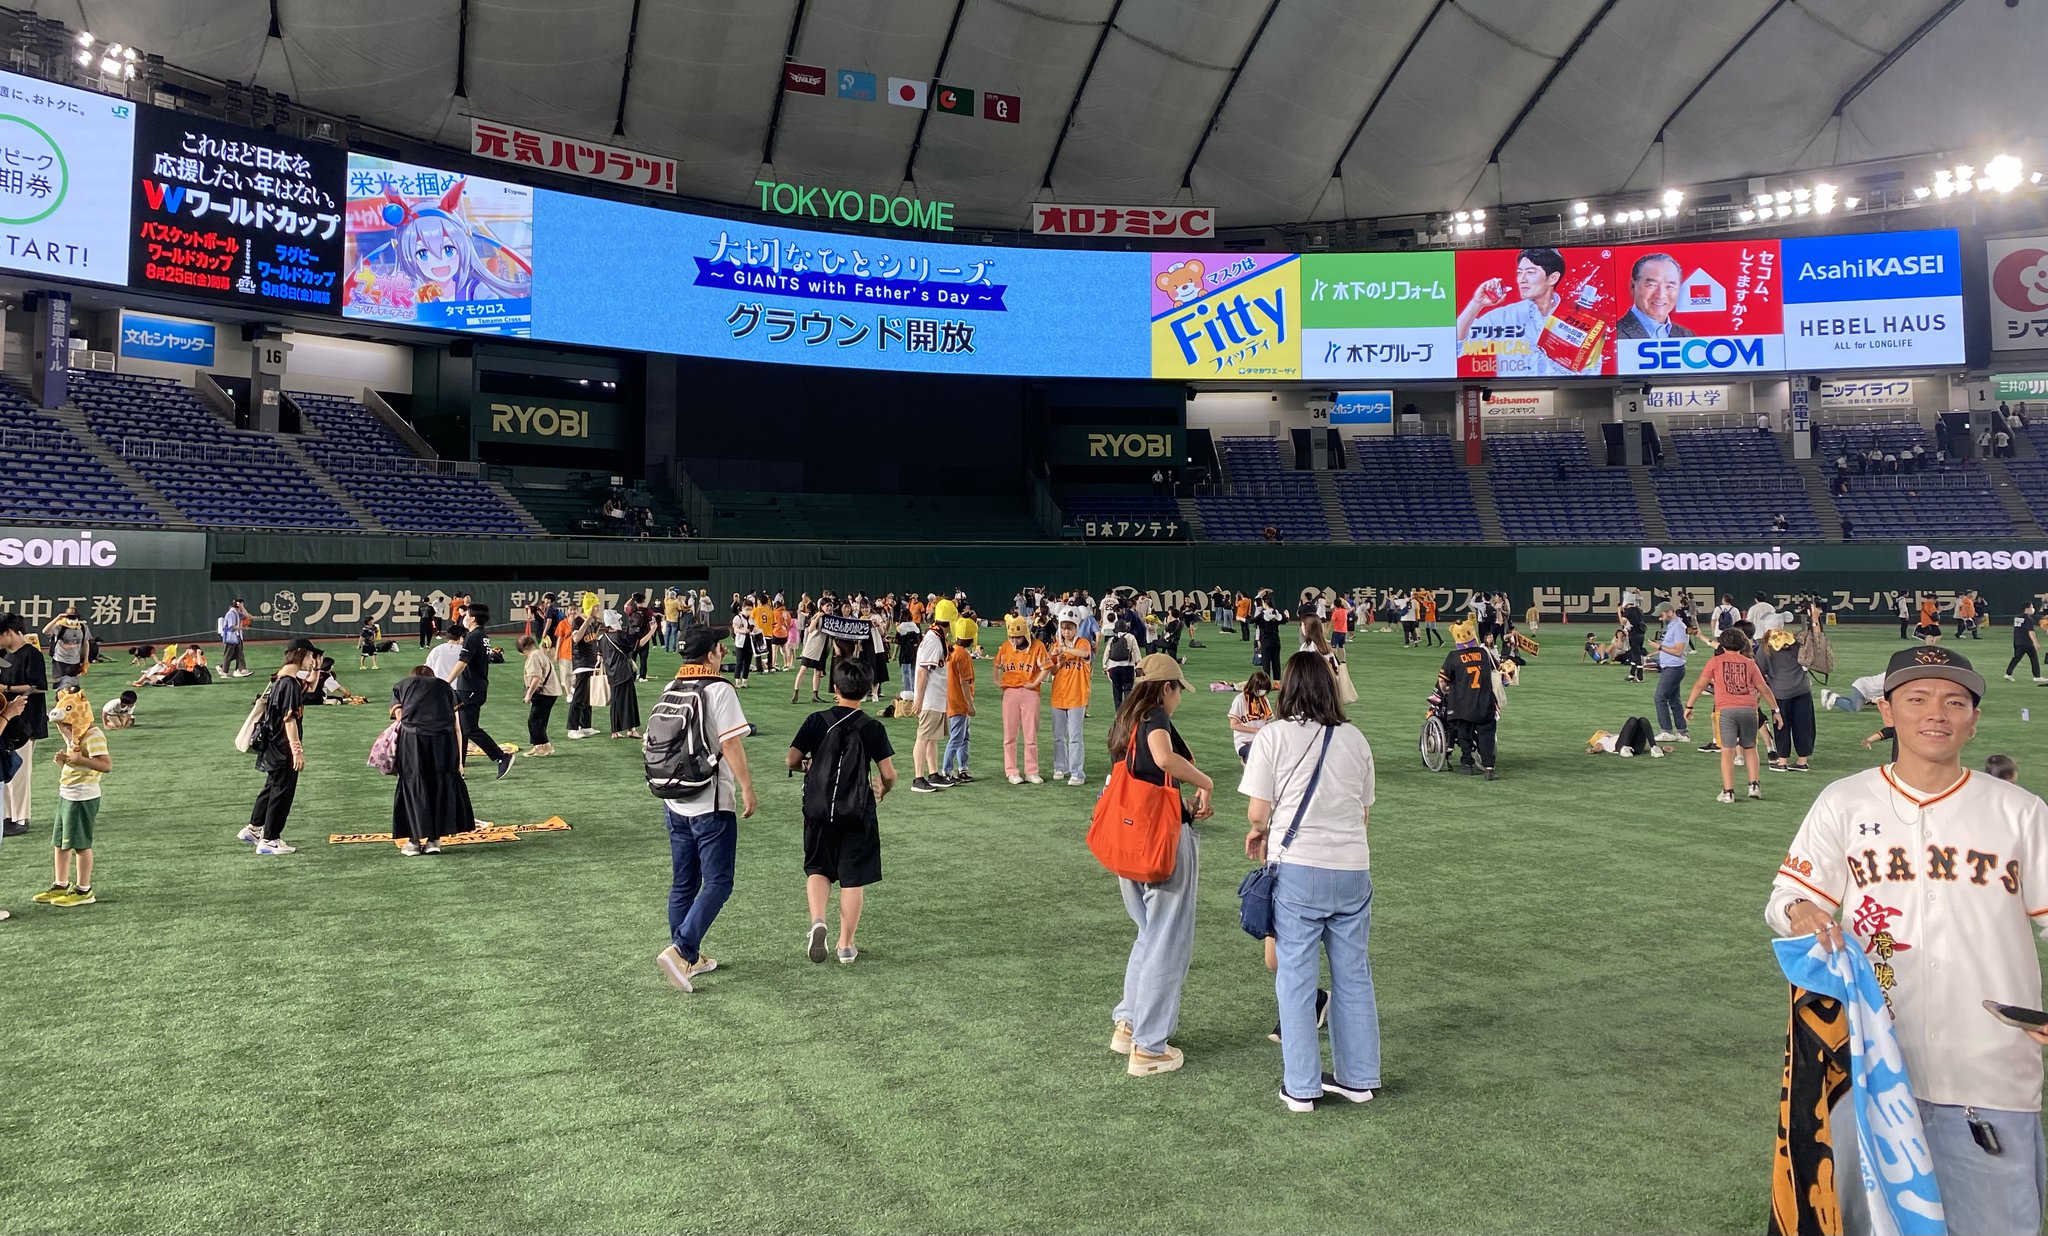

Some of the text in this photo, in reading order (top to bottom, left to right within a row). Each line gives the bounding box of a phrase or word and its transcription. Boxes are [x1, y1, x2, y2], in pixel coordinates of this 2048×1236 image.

[111, 105, 130, 118] JR
[0, 146, 54, 171] ピーク
[181, 131, 312, 180] これほど日本を、
[475, 123, 675, 191] 元気ハツラツ!
[153, 152, 336, 209] 応援したい年はない。
[185, 188, 342, 240] ワールドカップ
[754, 179, 955, 232] TOKYO DOME
[1038, 207, 1211, 237] オロナミンC
[140, 221, 240, 254] バスケットボール
[0, 234, 89, 268] TART!
[148, 243, 234, 273] ワールドカップ
[275, 243, 320, 266] ラグビー
[708, 230, 997, 288] 大切なひとシリーズ
[257, 261, 337, 288] ワールドカップ
[1206, 256, 1258, 285] マスクは
[1753, 250, 1775, 303] セコム、
[733, 270, 970, 306] GIANTS with Father's Day
[1332, 280, 1447, 301] 木下のリフォーム
[1731, 248, 1755, 331] してますか?
[445, 303, 506, 317] タマモクロス
[726, 301, 977, 356] グラウンド開放
[1169, 287, 1289, 367] Fitty
[1471, 325, 1526, 339] アリナミン
[1800, 313, 1947, 338] HEBEL HAUS
[265, 348, 282, 364] 16
[1208, 337, 1271, 374] フィッティ
[1346, 343, 1434, 364] 木下グループ
[1462, 339, 1535, 356] MEDICAL
[1637, 337, 1765, 370] SECOM
[1834, 338, 1913, 351] ALL for LONGLIFE
[1471, 357, 1525, 373] balance
[1485, 394, 1540, 406] Bishamon
[1646, 390, 1721, 408] 昭和大学
[1821, 381, 1910, 398] ニッテイライフ
[1978, 389, 1986, 401] 1
[1312, 408, 1328, 419] 34
[1628, 401, 1637, 413] 3
[1792, 390, 1809, 433] 関電工
[490, 403, 589, 438] RYOBI
[1088, 433, 1172, 458] RYOBI
[1085, 521, 1178, 537] 日本アンテナ
[1640, 546, 1801, 571] Panasonic
[761, 614, 768, 624] 9
[1466, 665, 1481, 689] 7
[1724, 662, 1746, 674] ABER
[1846, 844, 2021, 896] GIANTS
